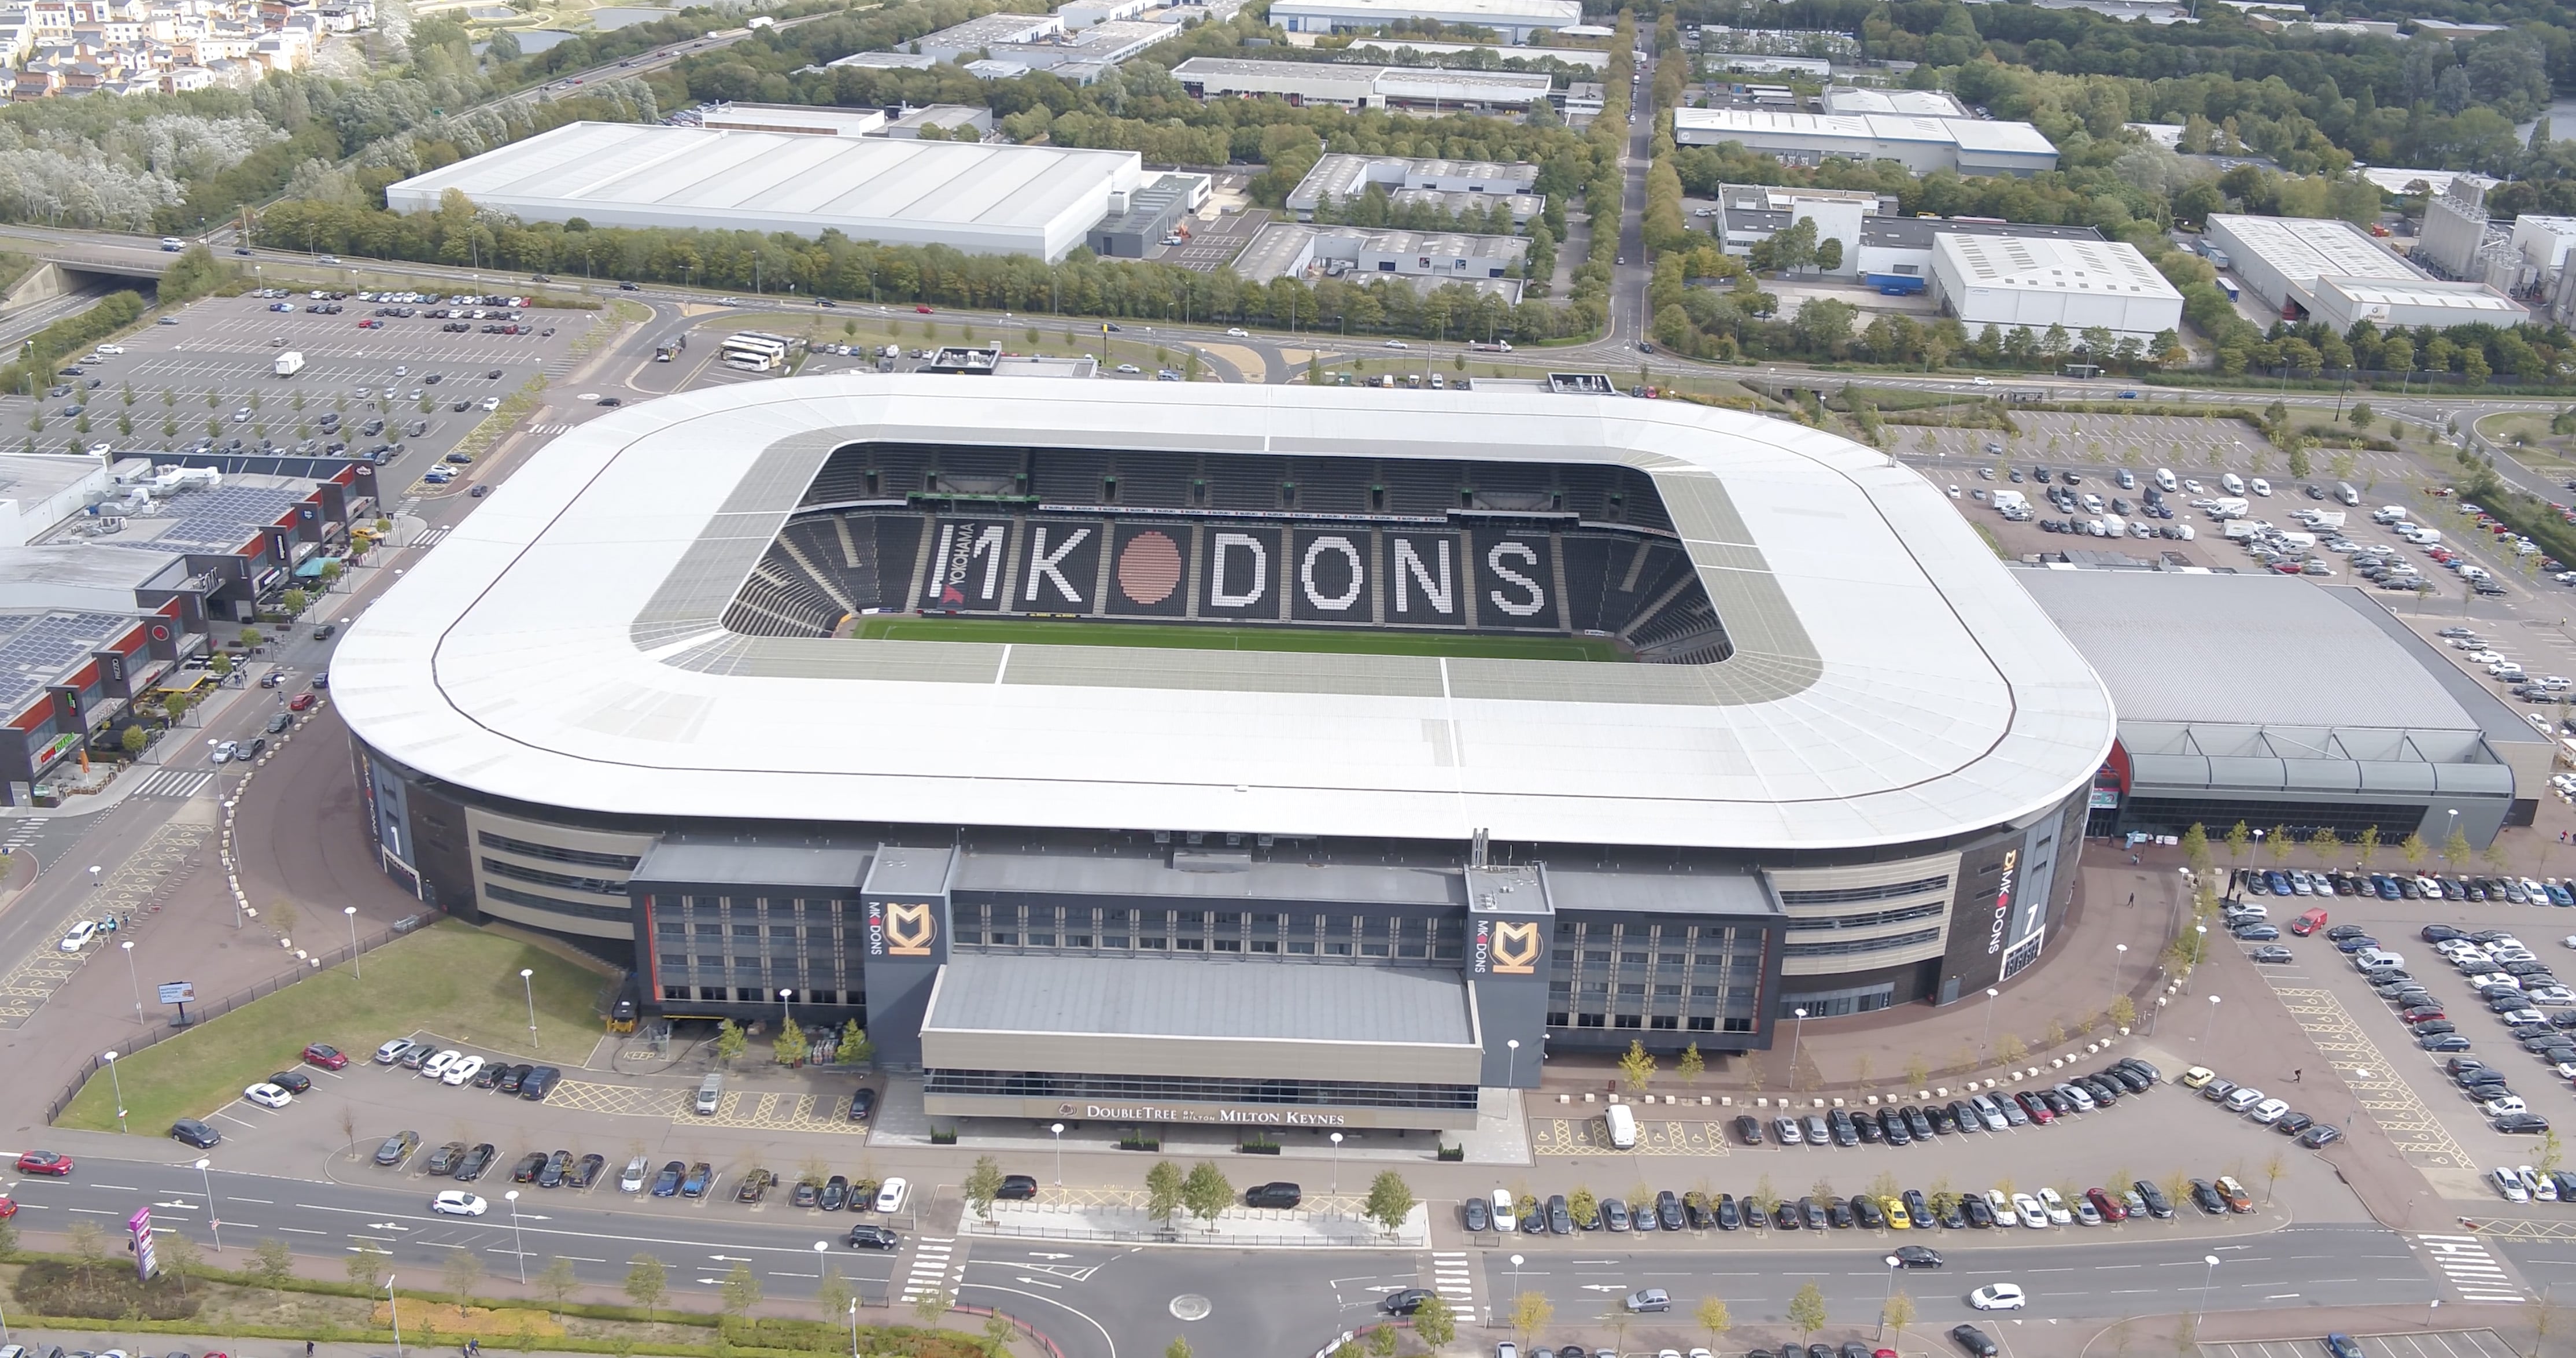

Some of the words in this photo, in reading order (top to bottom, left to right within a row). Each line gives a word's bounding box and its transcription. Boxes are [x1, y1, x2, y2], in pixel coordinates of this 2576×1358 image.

[949, 523, 975, 585] YOKOHAMA
[1212, 533, 1545, 615] DONS
[368, 797, 378, 835] DONS
[390, 826, 401, 855] 1
[2000, 870, 2014, 896] MK
[869, 902, 880, 918] MK
[2025, 903, 2038, 935] 1
[870, 925, 882, 955] DONS
[1477, 920, 1488, 936] MK
[1988, 906, 2006, 954] DONS
[1475, 944, 1487, 973] DONS
[623, 1051, 655, 1060] KEEP
[1220, 1109, 1280, 1123] MILTON
[1287, 1112, 1345, 1125] KEYNES
